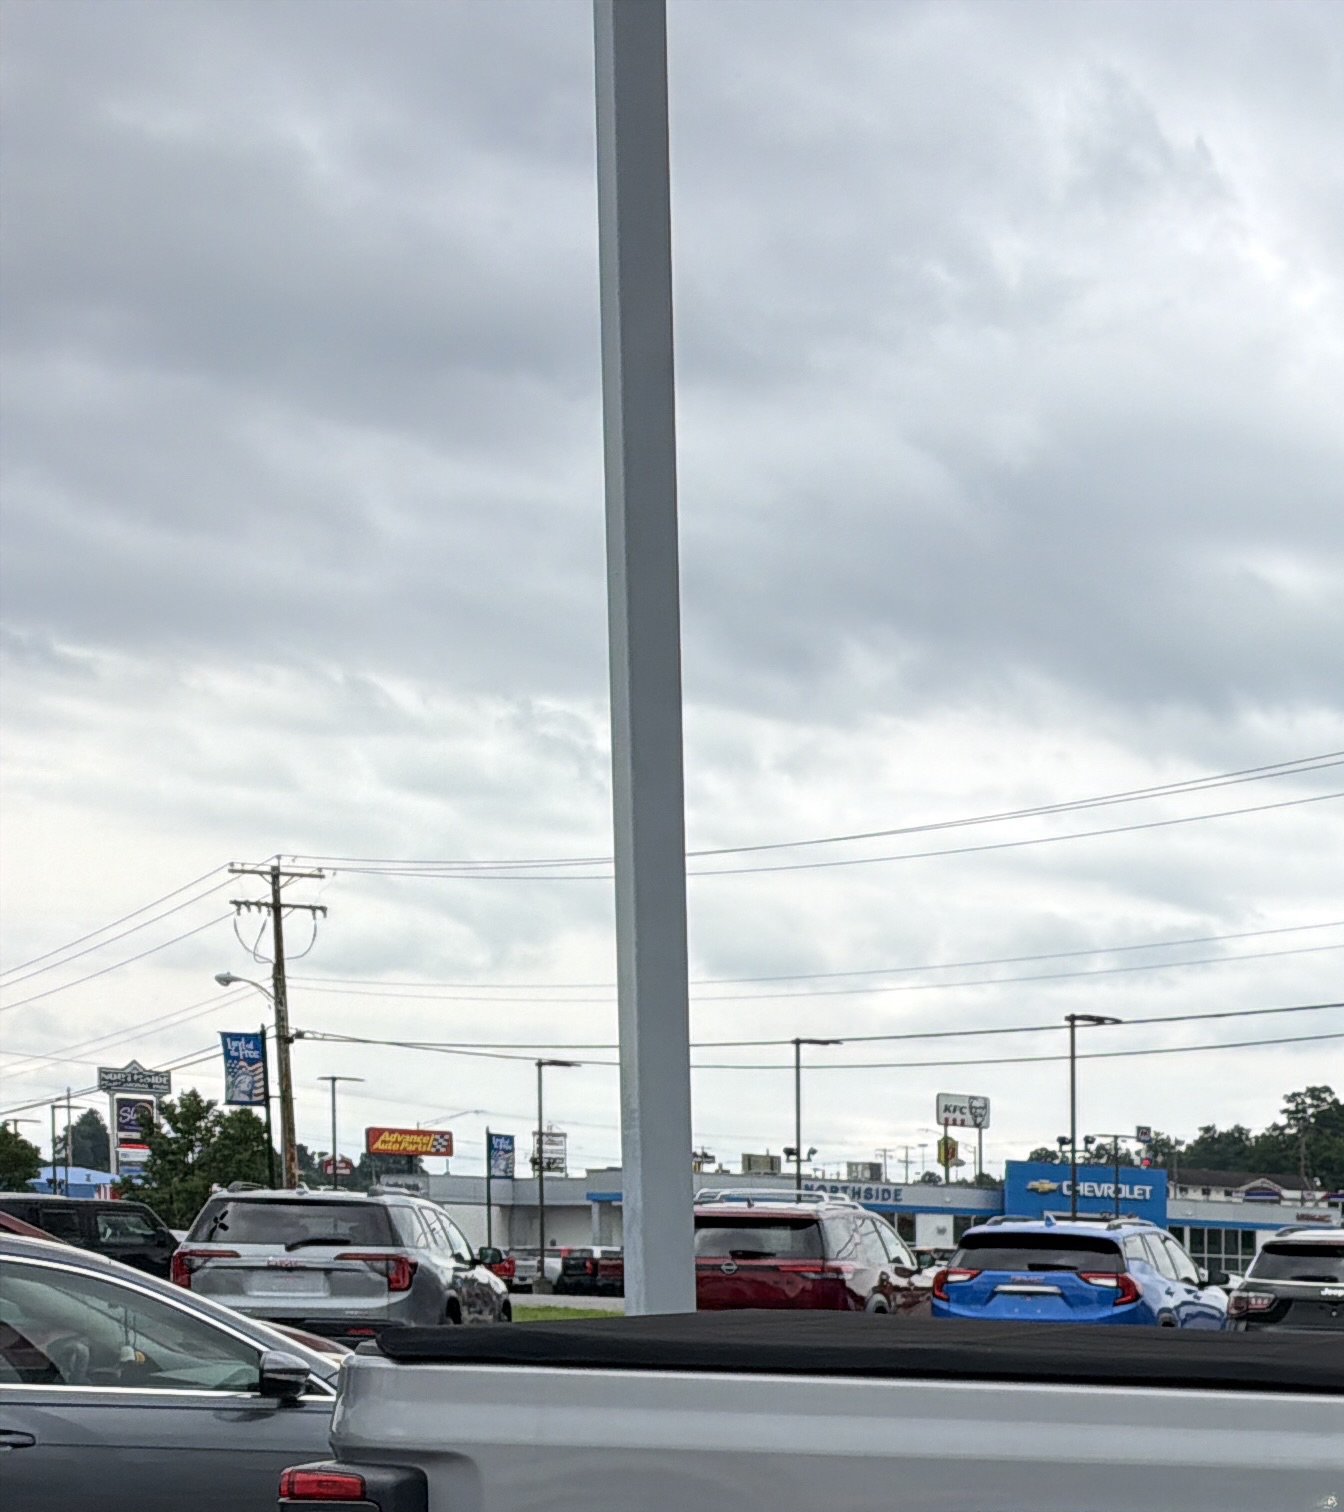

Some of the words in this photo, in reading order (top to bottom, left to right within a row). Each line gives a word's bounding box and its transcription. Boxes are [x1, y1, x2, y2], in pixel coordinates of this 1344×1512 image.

[943, 1104, 967, 1115] KFC
[380, 1131, 430, 1142] Advance
[372, 1141, 400, 1150] Auto
